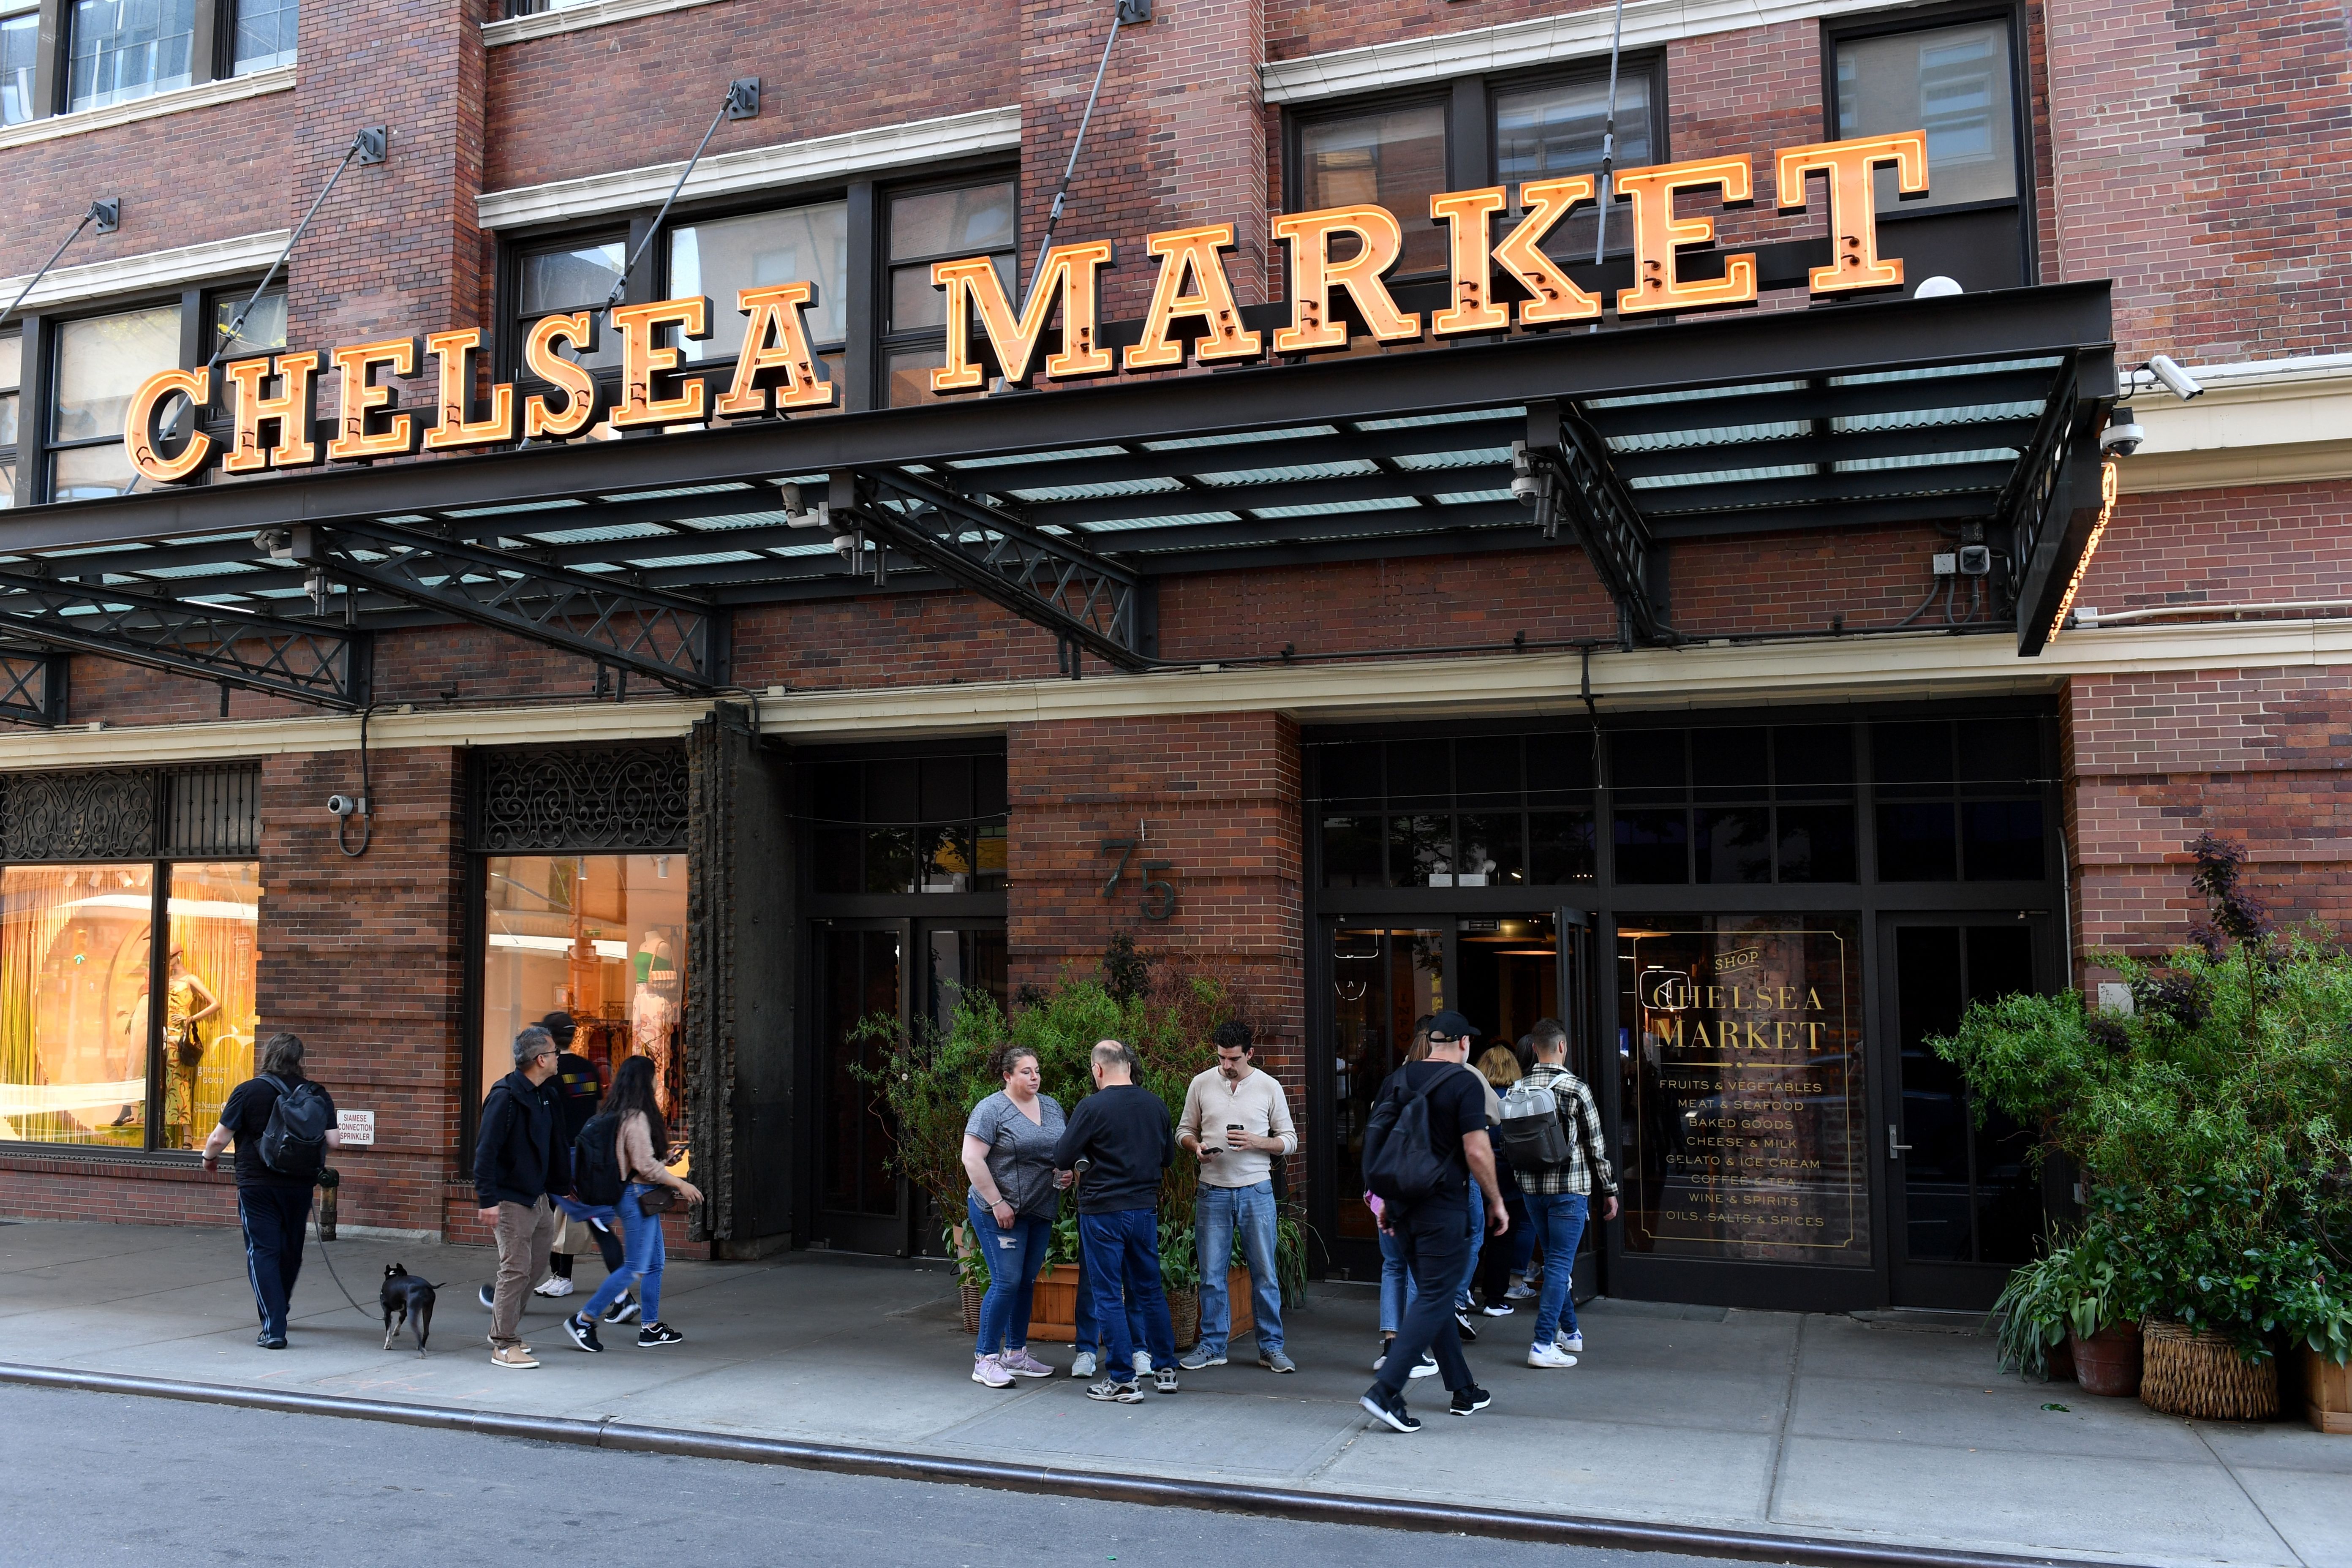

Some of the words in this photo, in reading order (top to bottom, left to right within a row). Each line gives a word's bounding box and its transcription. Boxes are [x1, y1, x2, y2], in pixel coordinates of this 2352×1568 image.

[125, 280, 840, 485] CHELSEA
[929, 128, 1929, 395] MARKET
[1101, 838, 1174, 920] 75
[1715, 951, 1758, 970] SHOP
[1653, 985, 1825, 1010] CHELSEA
[1654, 1020, 1826, 1050] MARKET
[198, 1067, 229, 1076] greater
[1660, 1080, 1709, 1089] FRUITS
[1728, 1081, 1822, 1092] VEGETABLES
[1678, 1100, 1714, 1108] MEAT
[1734, 1100, 1804, 1111] SEAFOOD
[344, 1114, 367, 1122] SIAMESE
[1689, 1118, 1736, 1128] BAKED
[1741, 1120, 1793, 1130] GOODS
[338, 1123, 372, 1131] CONNECTION
[340, 1132, 370, 1141] SPRINKLER
[1686, 1136, 1744, 1147] CHEESE
[1750, 1140, 1758, 1148] &
[1764, 1140, 1797, 1149] MILK
[1666, 1154, 1720, 1165] GELATO
[1740, 1157, 1763, 1167] ICE
[1769, 1159, 1820, 1169] CREAM
[1691, 1174, 1748, 1185] COFFEE
[1754, 1178, 1762, 1186] &
[1768, 1177, 1796, 1187] TEA
[1689, 1193, 1723, 1203] WINE
[1743, 1195, 1799, 1206] SPIRITS
[1666, 1211, 1702, 1222] OILS,
[1708, 1213, 1751, 1223] SALTS
[1757, 1216, 1765, 1224] &
[1771, 1216, 1824, 1226] SPICES
[576, 1329, 587, 1338] N
